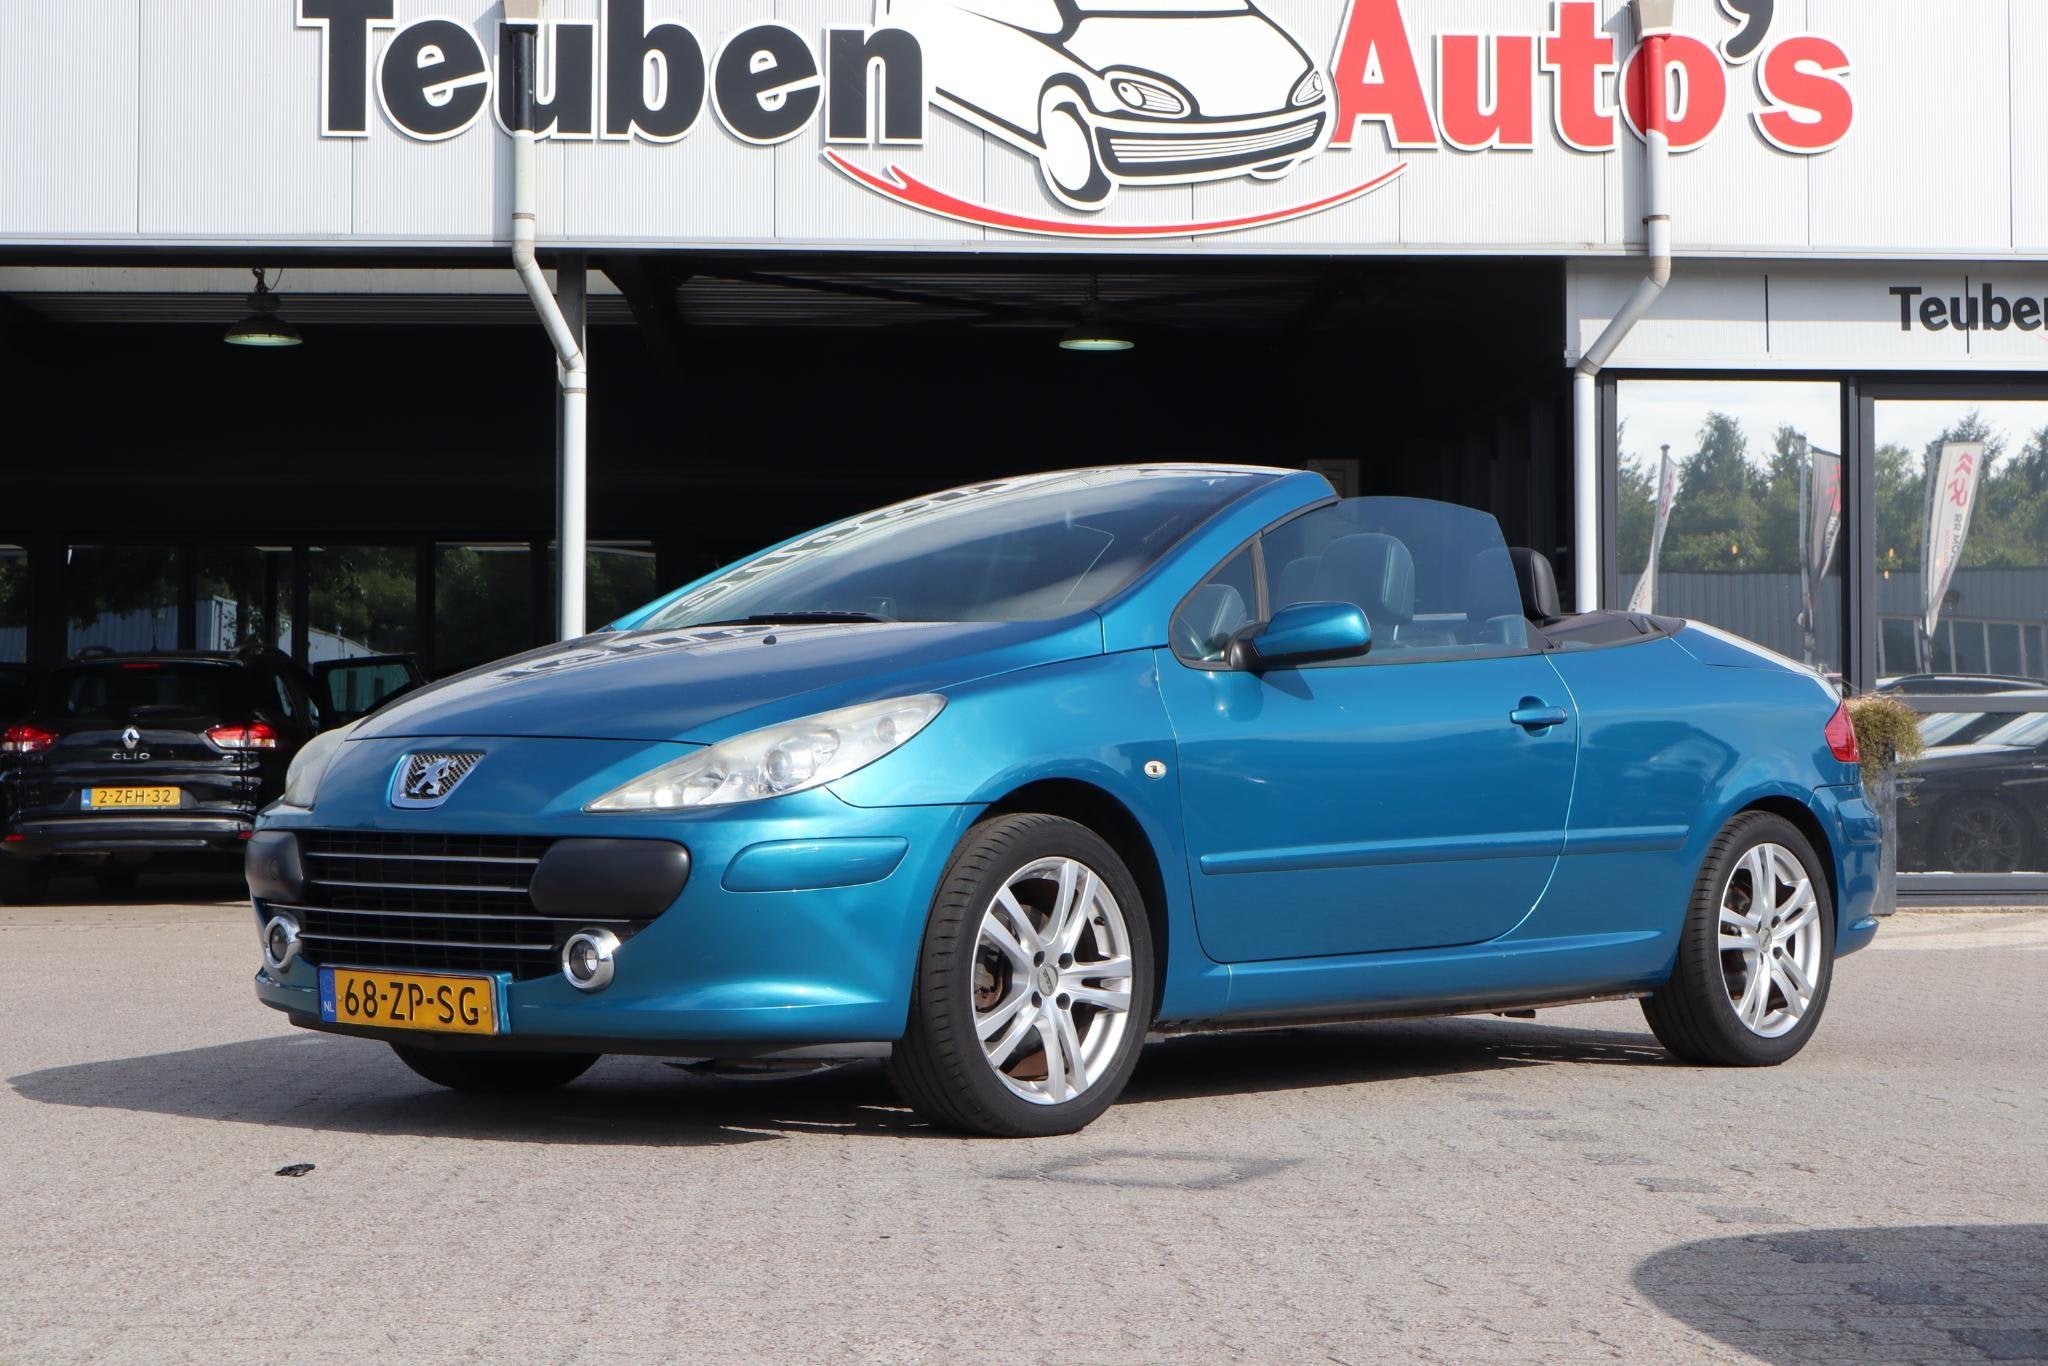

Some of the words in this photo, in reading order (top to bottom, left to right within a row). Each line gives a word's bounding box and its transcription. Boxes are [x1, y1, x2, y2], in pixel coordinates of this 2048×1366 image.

[298, 0, 924, 142] Teuben
[1331, 0, 1854, 151] Auto's
[1888, 283, 2048, 331] Teube
[111, 752, 150, 761] CLIO
[98, 788, 172, 804] 2-ZFH-32
[323, 1000, 335, 1013] NL
[344, 978, 479, 1026] 68-ZP-SG
